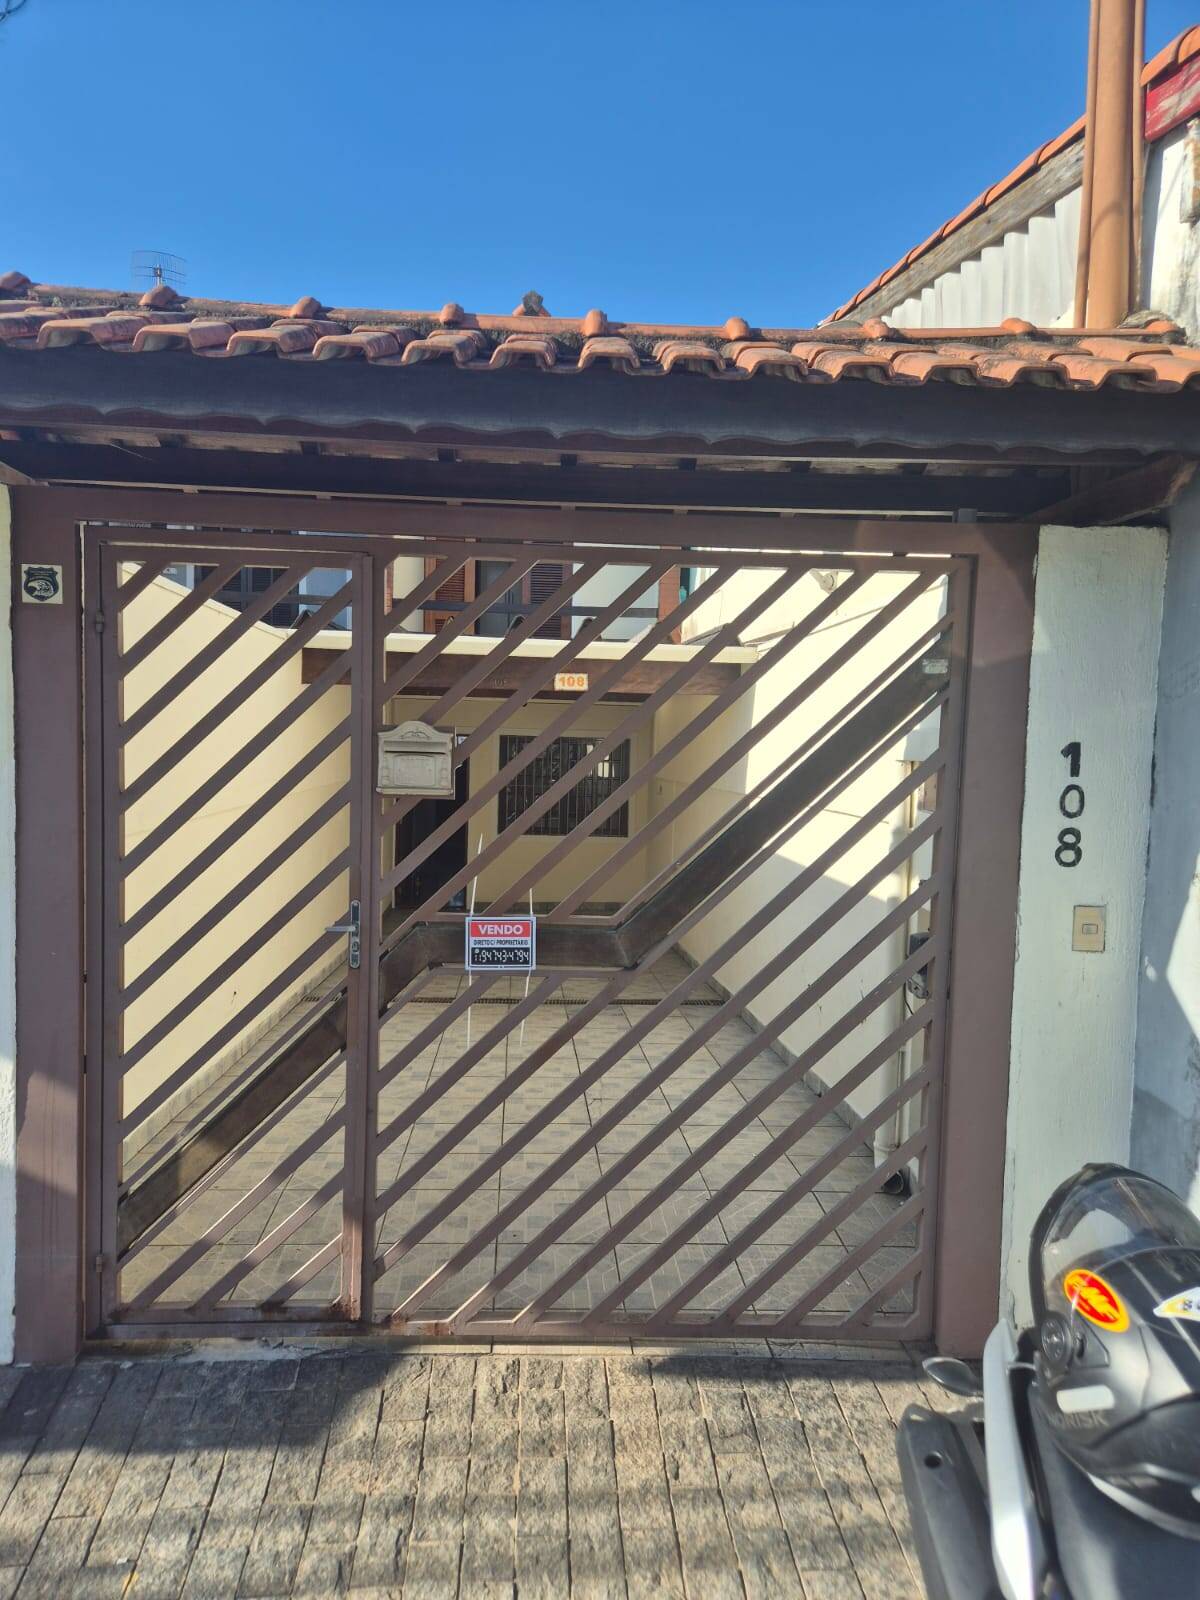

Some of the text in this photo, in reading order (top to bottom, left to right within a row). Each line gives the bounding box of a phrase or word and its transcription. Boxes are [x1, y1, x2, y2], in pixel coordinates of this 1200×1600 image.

[559, 676, 585, 688] 108
[1054, 741, 1085, 868] 108
[478, 924, 523, 935] VENDO
